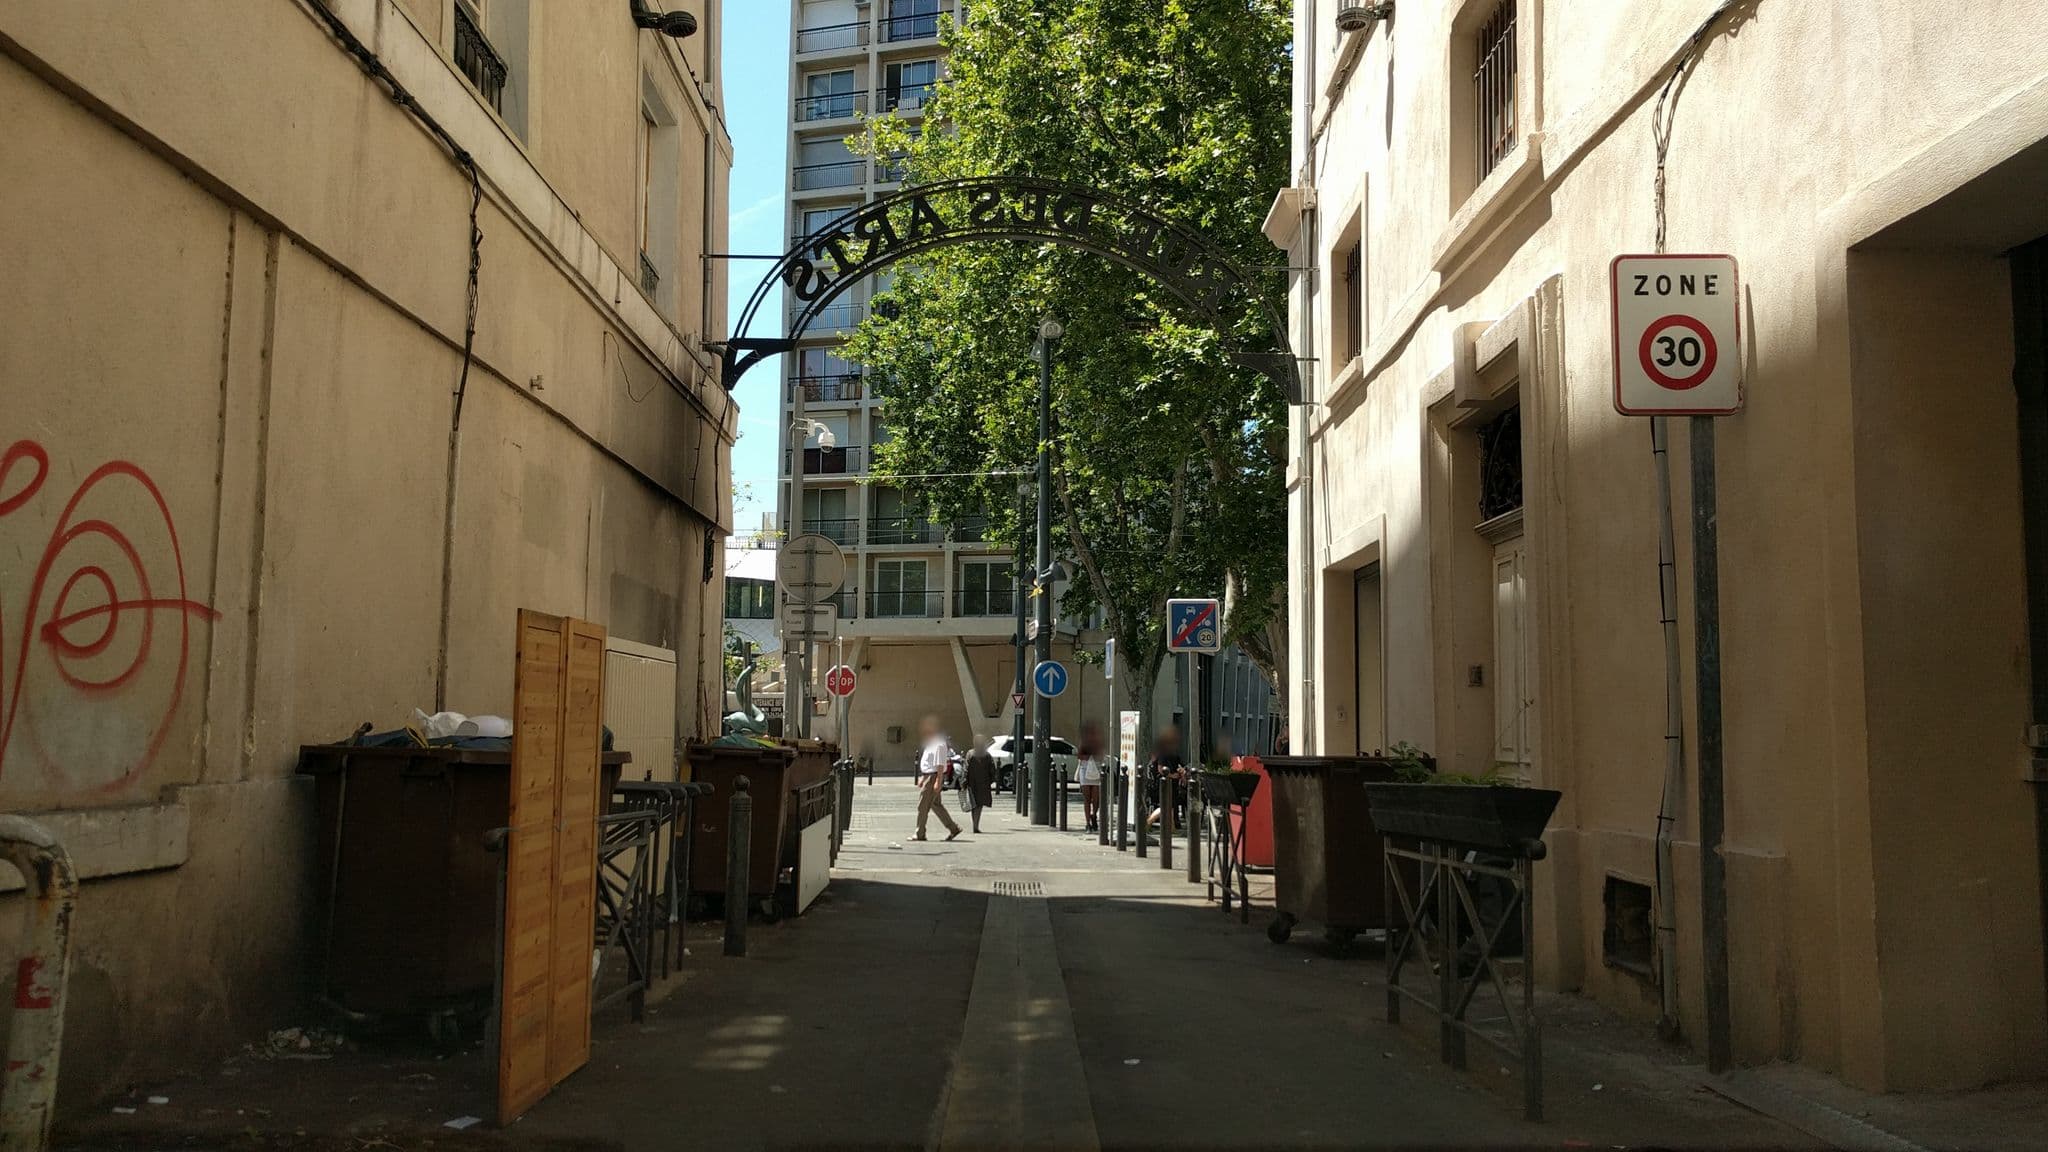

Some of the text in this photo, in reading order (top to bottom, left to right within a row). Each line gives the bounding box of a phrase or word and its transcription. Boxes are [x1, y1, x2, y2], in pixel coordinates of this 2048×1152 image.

[1634, 275, 1719, 296] ZONE
[1656, 336, 1701, 367] 30
[1201, 633, 1212, 642] 20
[829, 677, 854, 687] SOP
